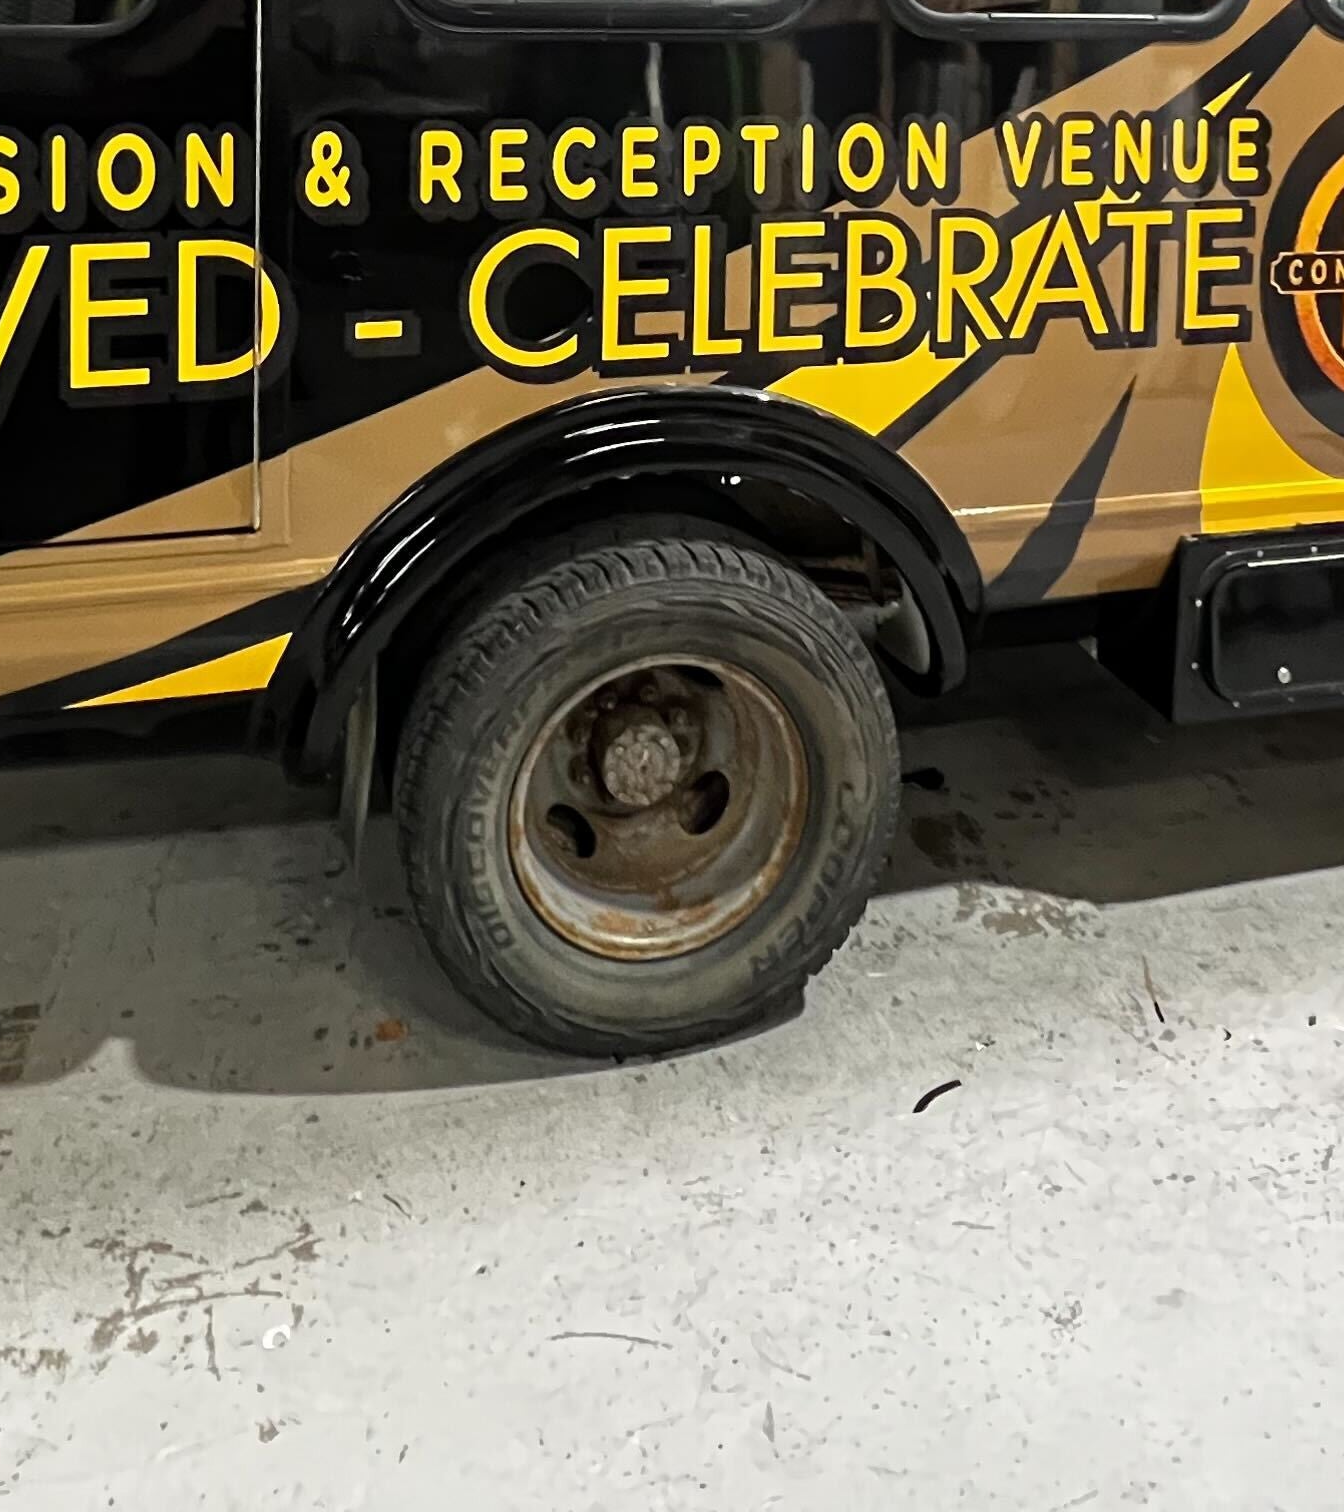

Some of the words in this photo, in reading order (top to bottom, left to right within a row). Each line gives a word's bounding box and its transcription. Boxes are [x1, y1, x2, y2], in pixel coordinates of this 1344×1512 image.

[304, 132, 350, 206] &
[419, 124, 948, 204] RECEPTION
[1002, 118, 1260, 188] VENUE
[469, 208, 1243, 367] CELEBRATE
